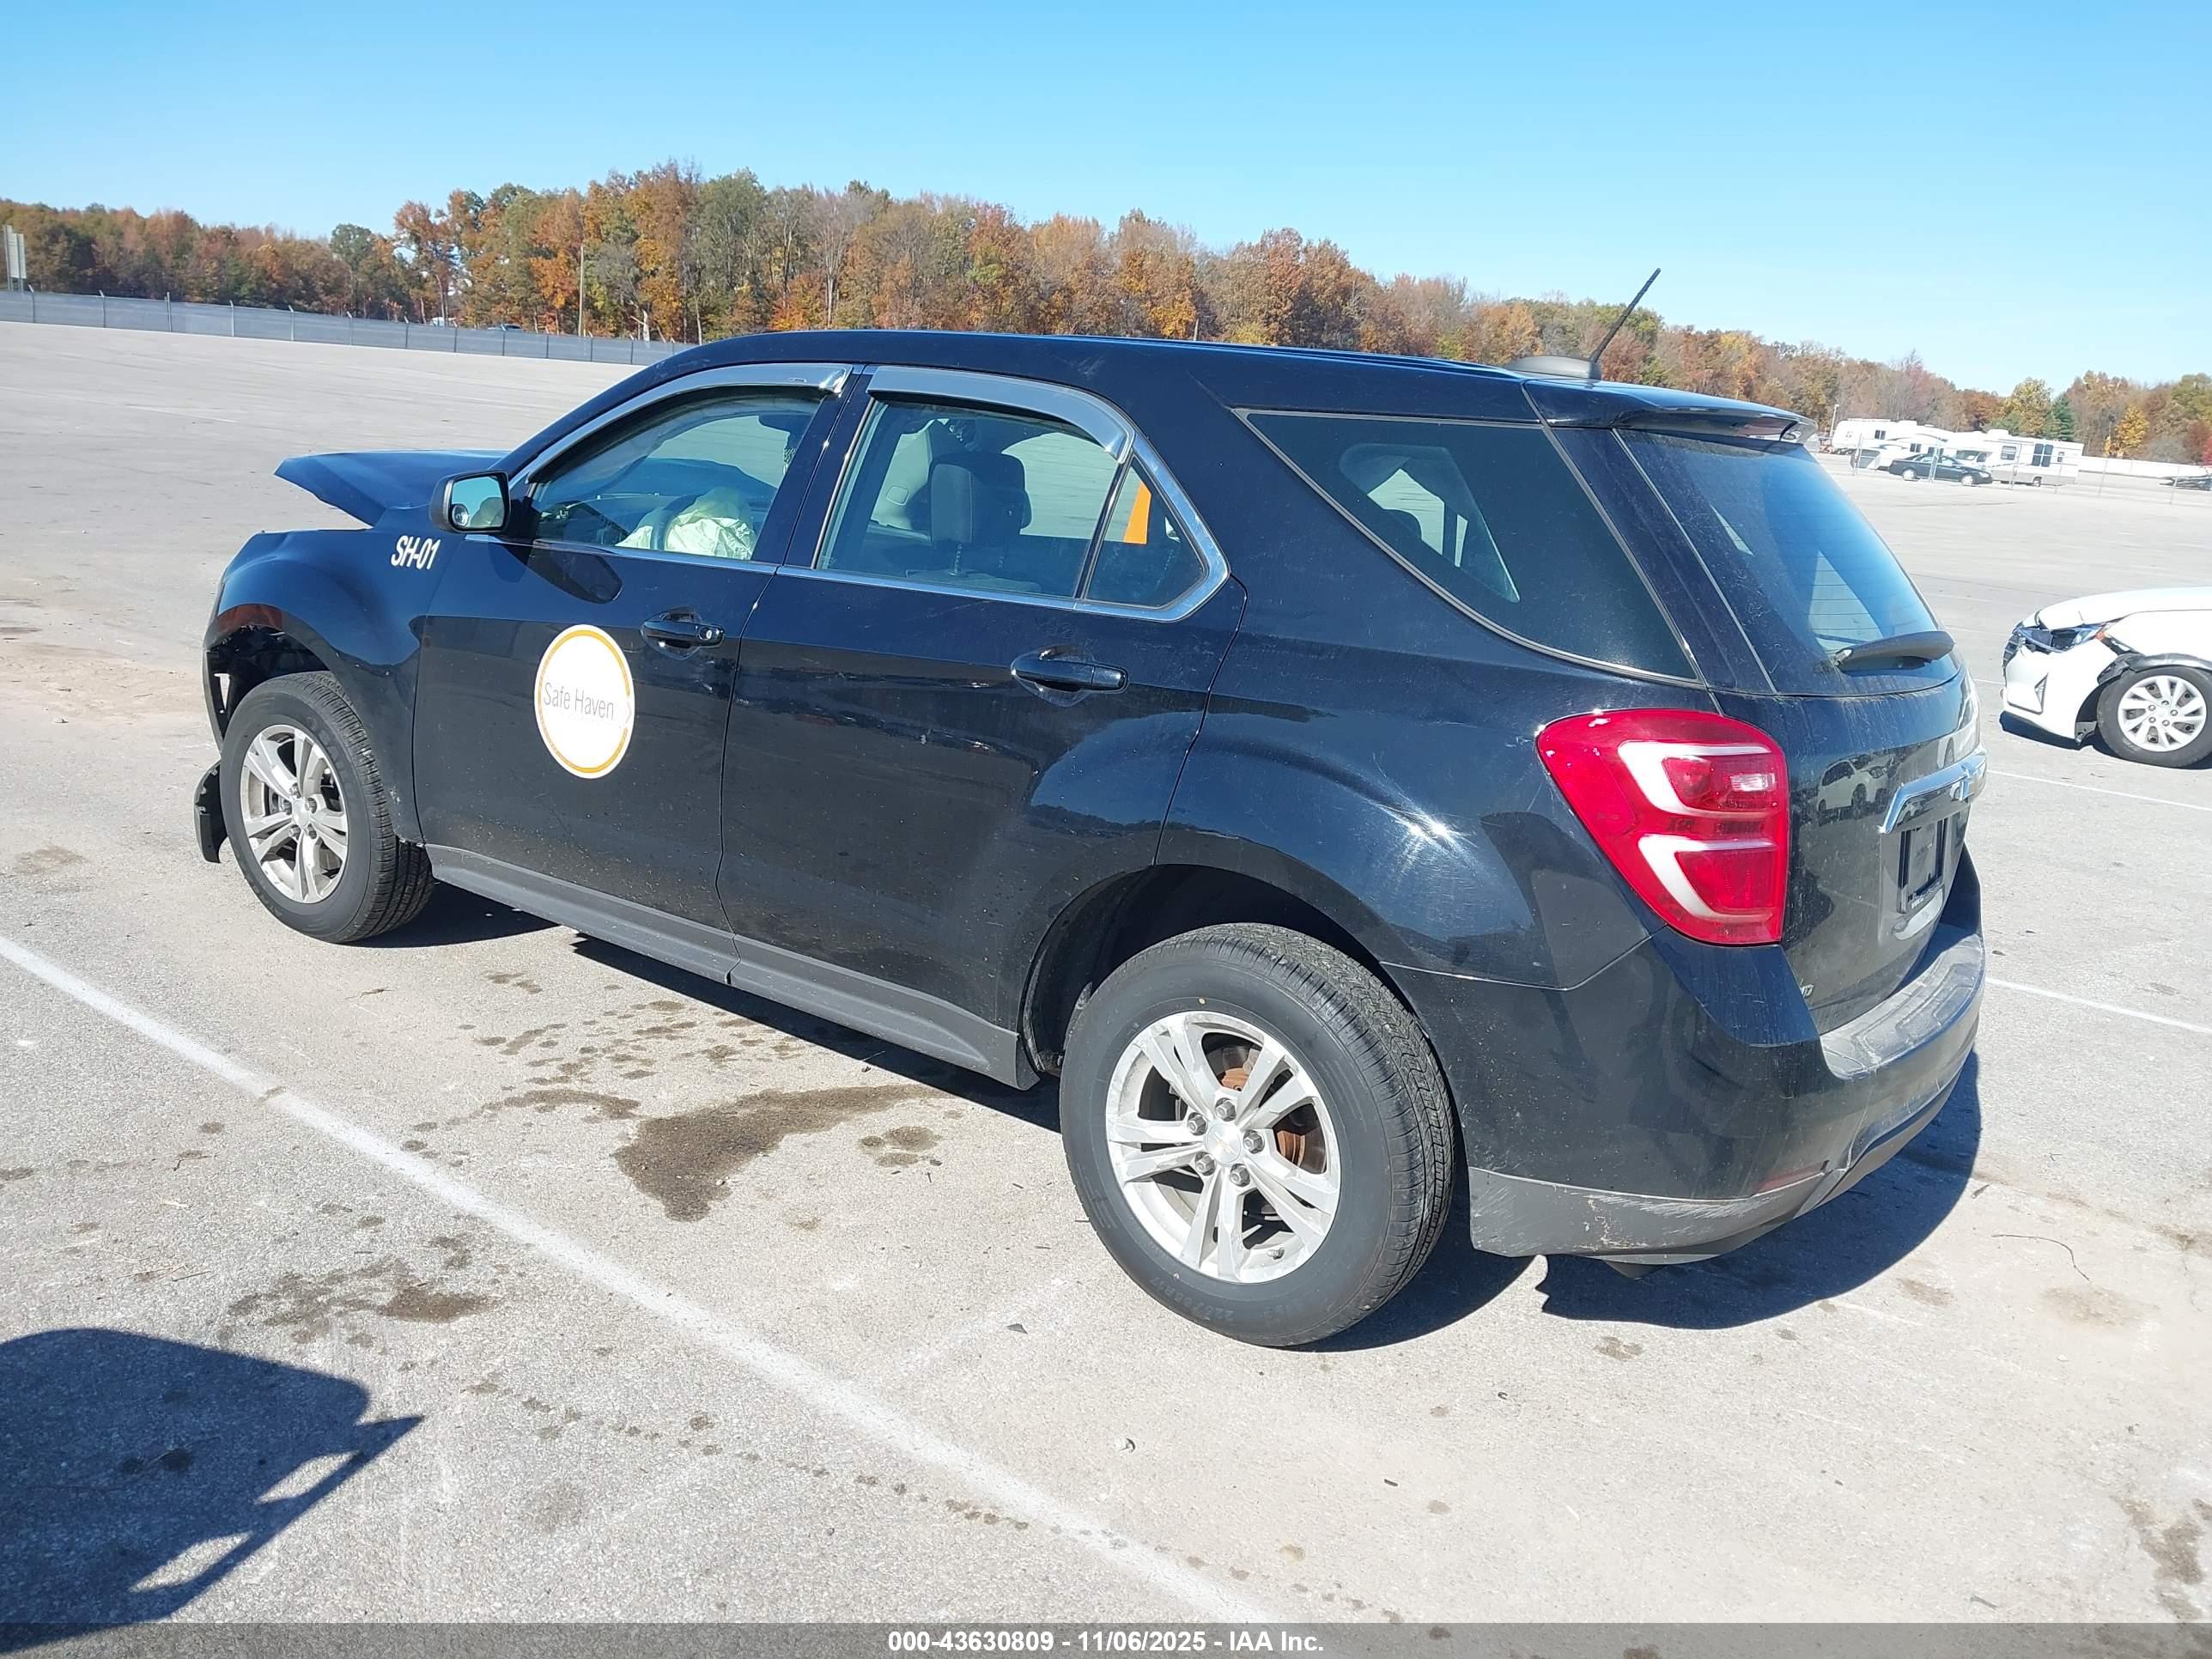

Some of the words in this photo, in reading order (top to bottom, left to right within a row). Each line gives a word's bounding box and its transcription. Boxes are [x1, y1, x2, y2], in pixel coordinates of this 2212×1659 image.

[391, 535, 441, 570] SH-01
[543, 682, 571, 710] Safe
[574, 687, 615, 720] Haven
